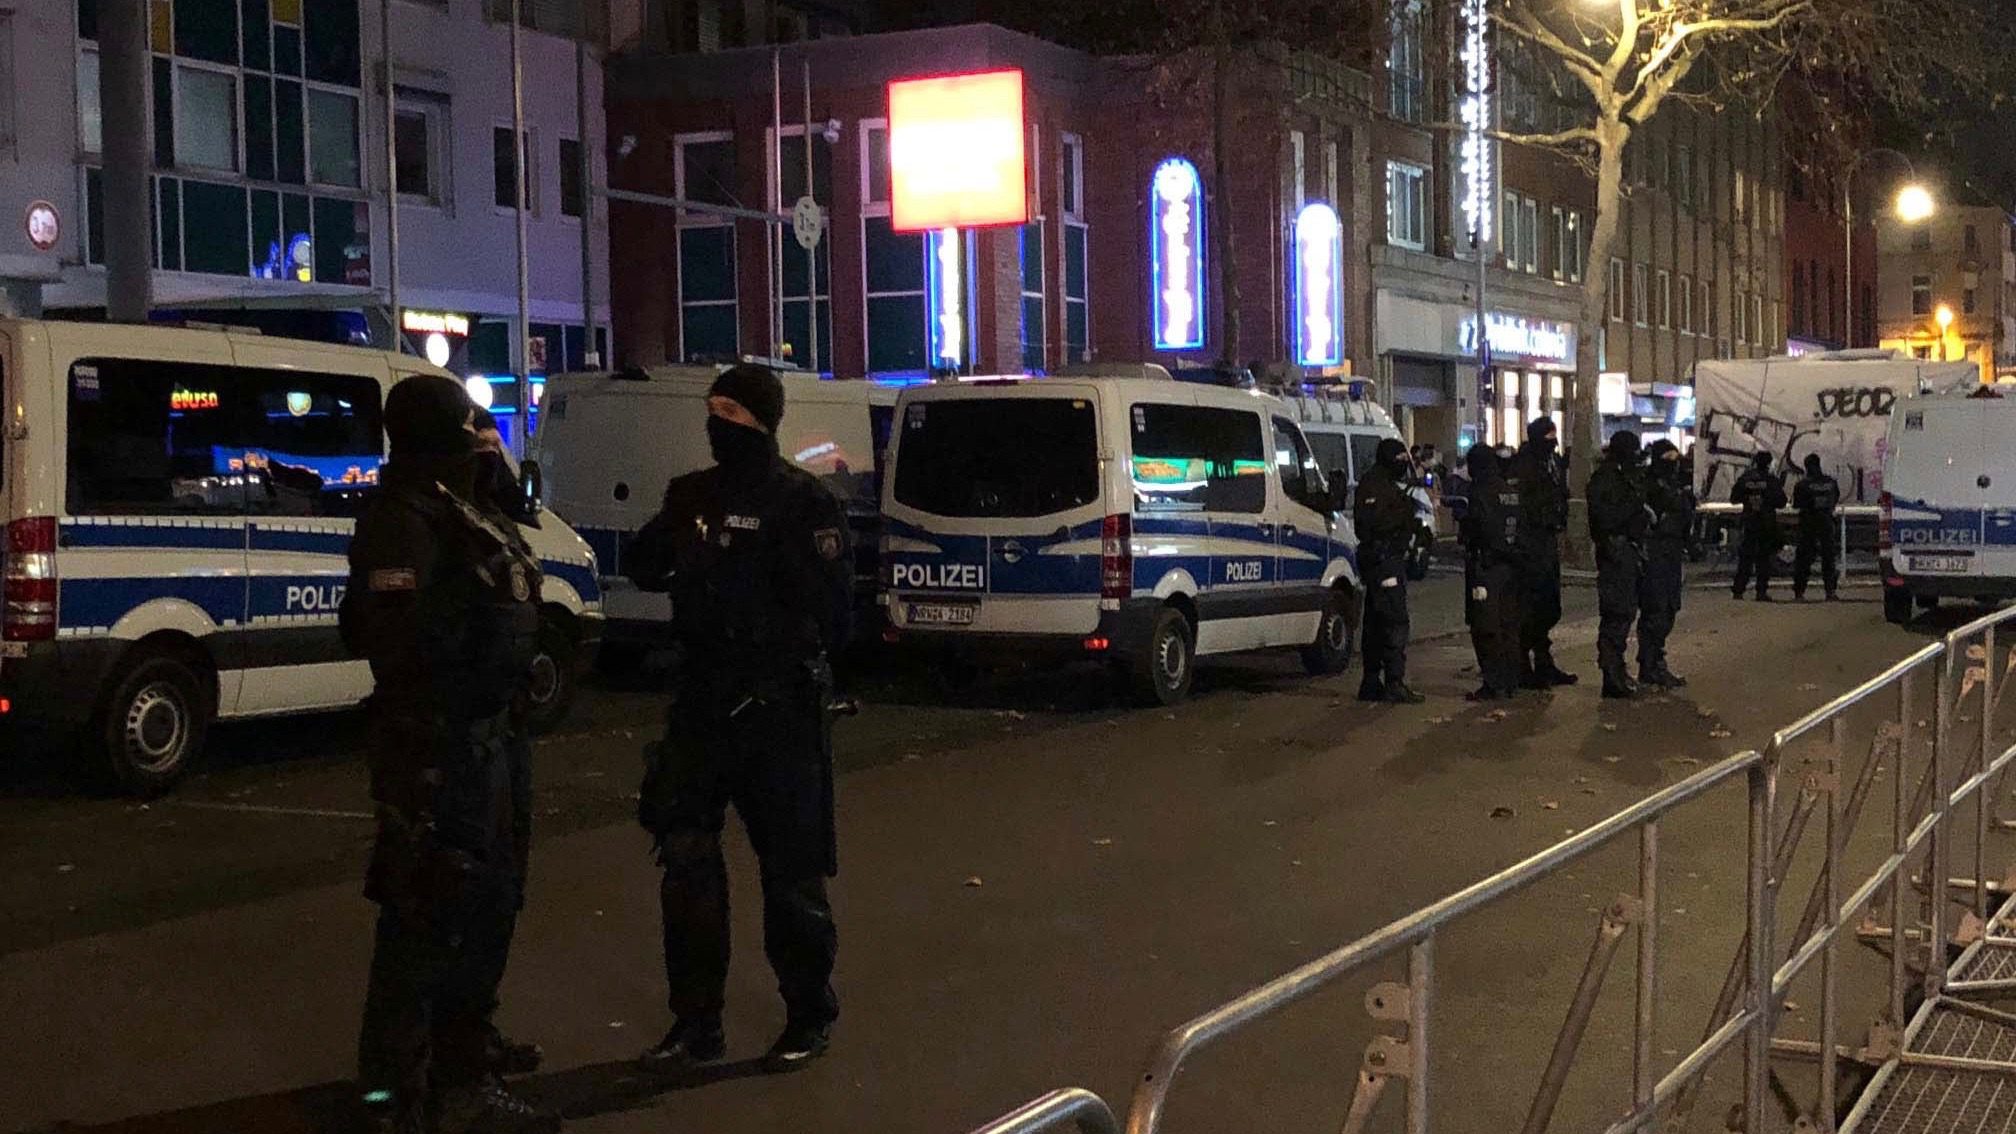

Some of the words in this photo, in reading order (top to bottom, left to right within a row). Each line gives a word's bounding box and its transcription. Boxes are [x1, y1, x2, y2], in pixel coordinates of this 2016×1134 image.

[1900, 528, 1977, 543] POLIZEI
[893, 563, 984, 588] POLIZEI
[1226, 561, 1262, 581] POLIZEI
[286, 585, 347, 610] POLIZ
